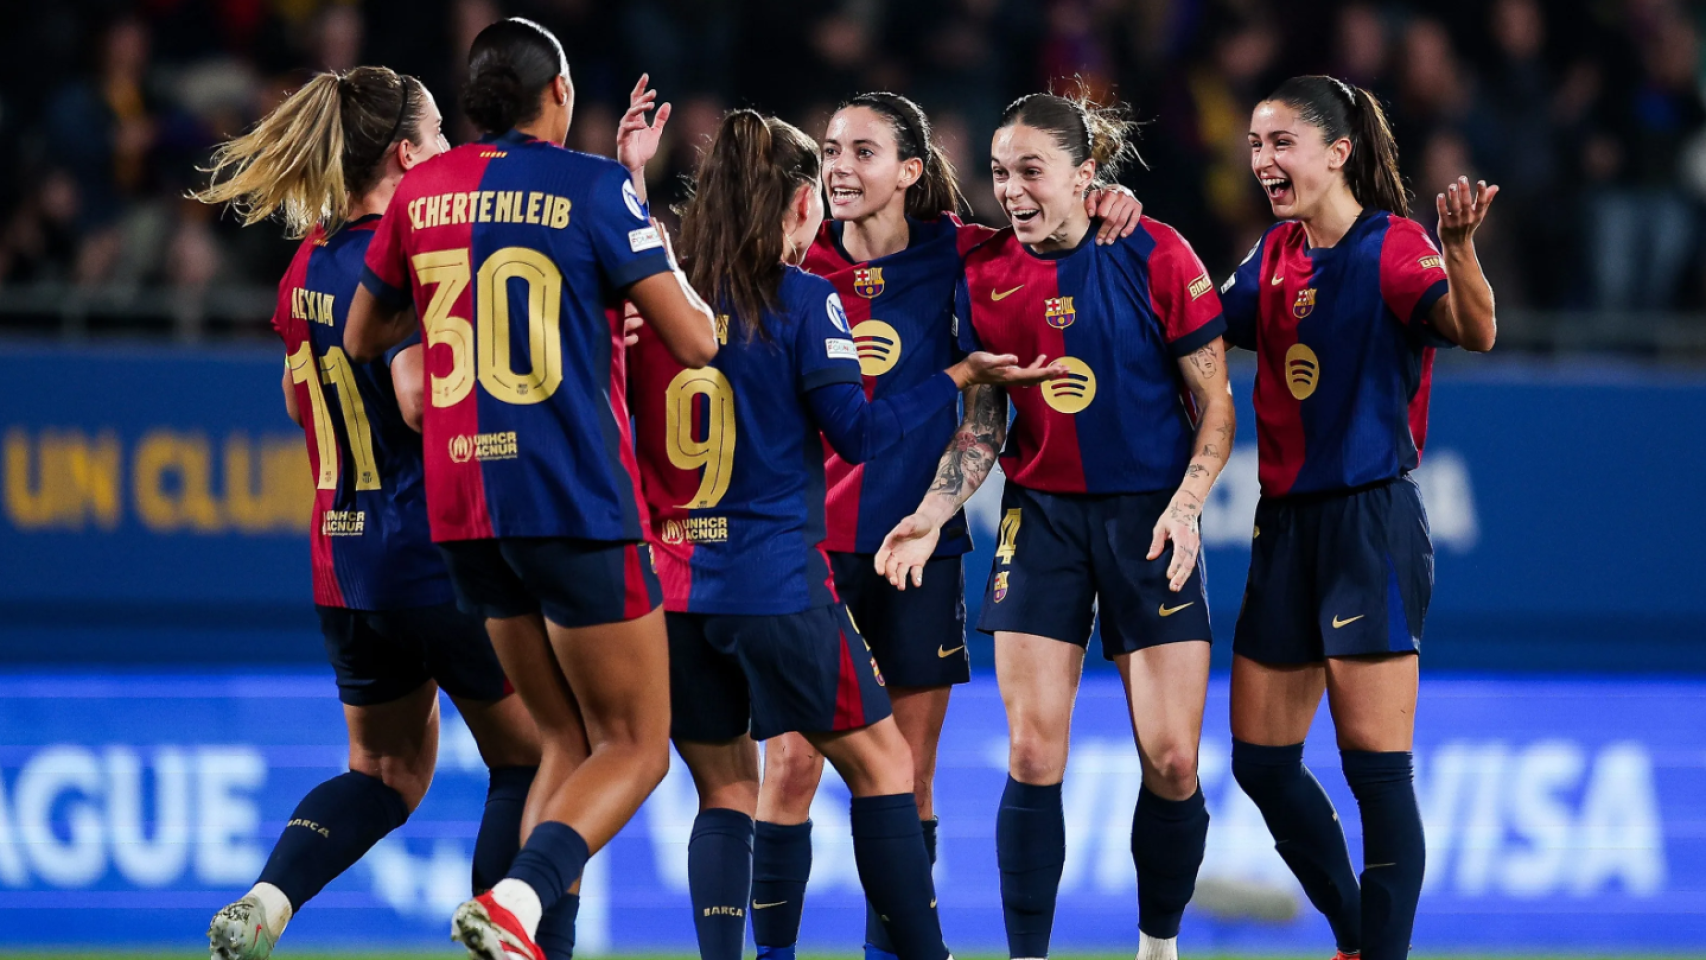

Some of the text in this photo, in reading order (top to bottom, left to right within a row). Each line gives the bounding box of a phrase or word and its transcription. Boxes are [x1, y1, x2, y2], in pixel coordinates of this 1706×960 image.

[407, 190, 572, 233] SCHERTENLEIB
[411, 246, 563, 408] 30
[288, 340, 382, 491] 11
[665, 365, 736, 509] 9
[474, 431, 516, 446] UNHCR
[475, 443, 517, 457] ACNUR
[682, 516, 727, 529] UNHCR
[686, 528, 727, 540] ACNUR
[996, 507, 1021, 565] 4
